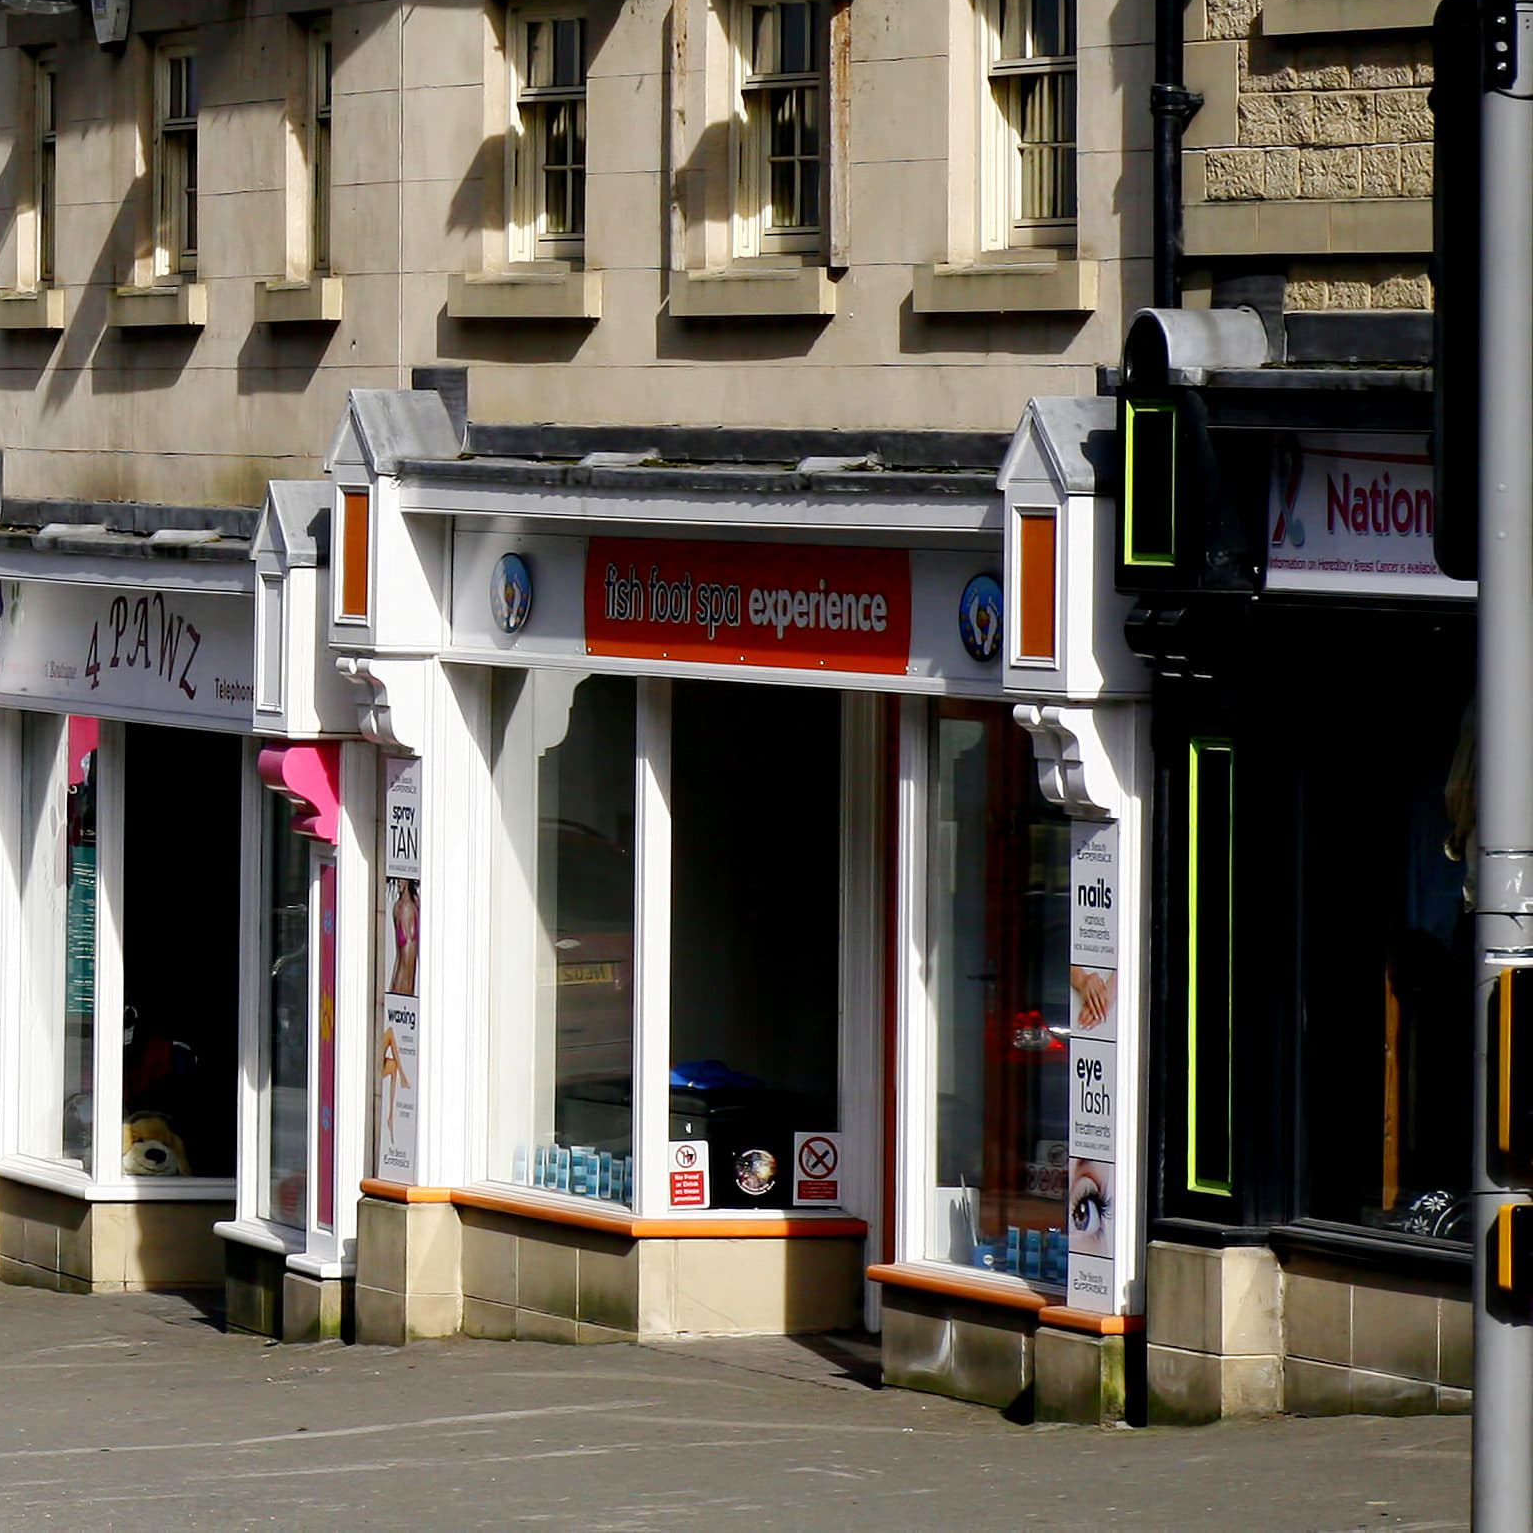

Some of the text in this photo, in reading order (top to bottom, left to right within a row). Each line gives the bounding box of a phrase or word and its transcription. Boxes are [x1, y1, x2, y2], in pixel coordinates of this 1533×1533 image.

[1269, 555, 1307, 570] Information
[605, 562, 888, 641] fish foot spa experience
[85, 591, 201, 700] 4 PAWZ
[393, 805, 416, 826] spray
[390, 825, 418, 861] TAN
[1078, 877, 1112, 909] nails
[1079, 927, 1110, 940] treatments
[388, 1006, 416, 1031] waxing
[1076, 1057, 1102, 1087] eye
[1081, 1080, 1110, 1116] lash
[1075, 1121, 1111, 1138] treatments
